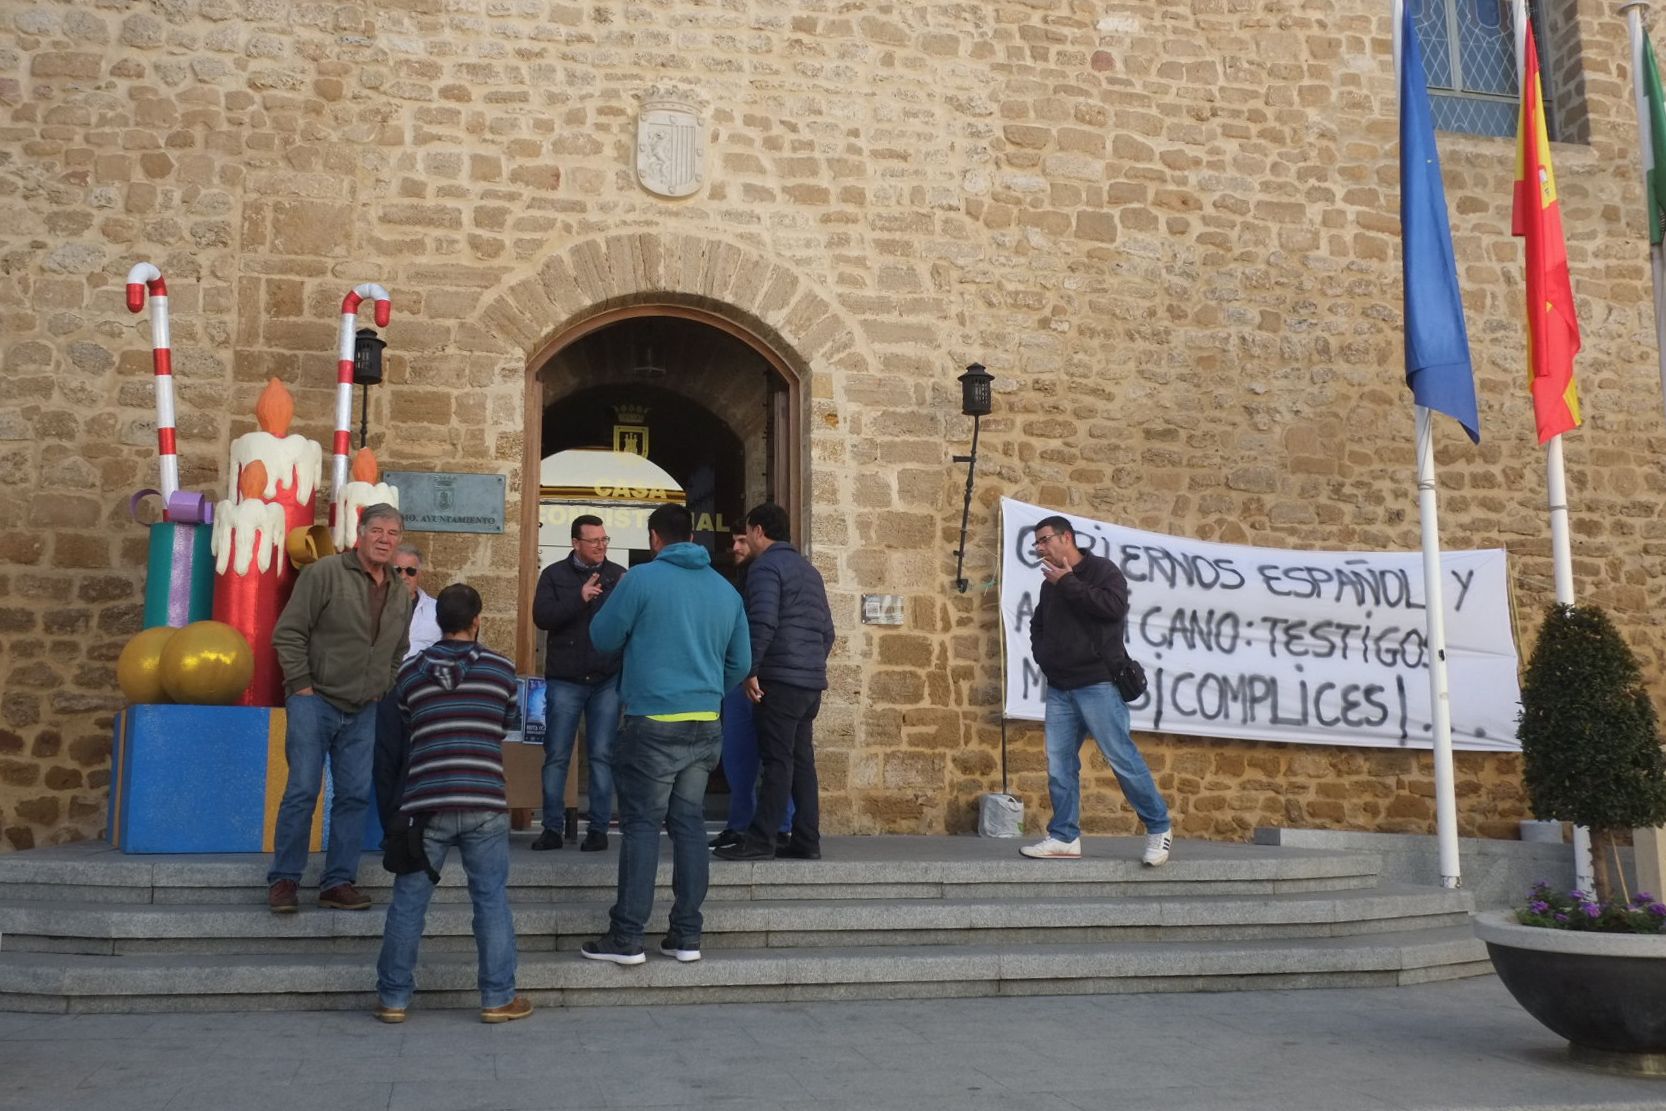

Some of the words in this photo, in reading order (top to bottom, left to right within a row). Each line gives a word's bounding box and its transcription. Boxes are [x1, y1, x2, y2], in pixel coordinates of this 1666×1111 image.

[593, 479, 667, 499] CASA
[420, 514, 496, 524] AYUNTAMIENTO
[1257, 559, 1427, 609] ESPAÑOL
[1450, 569, 1474, 612] Y
